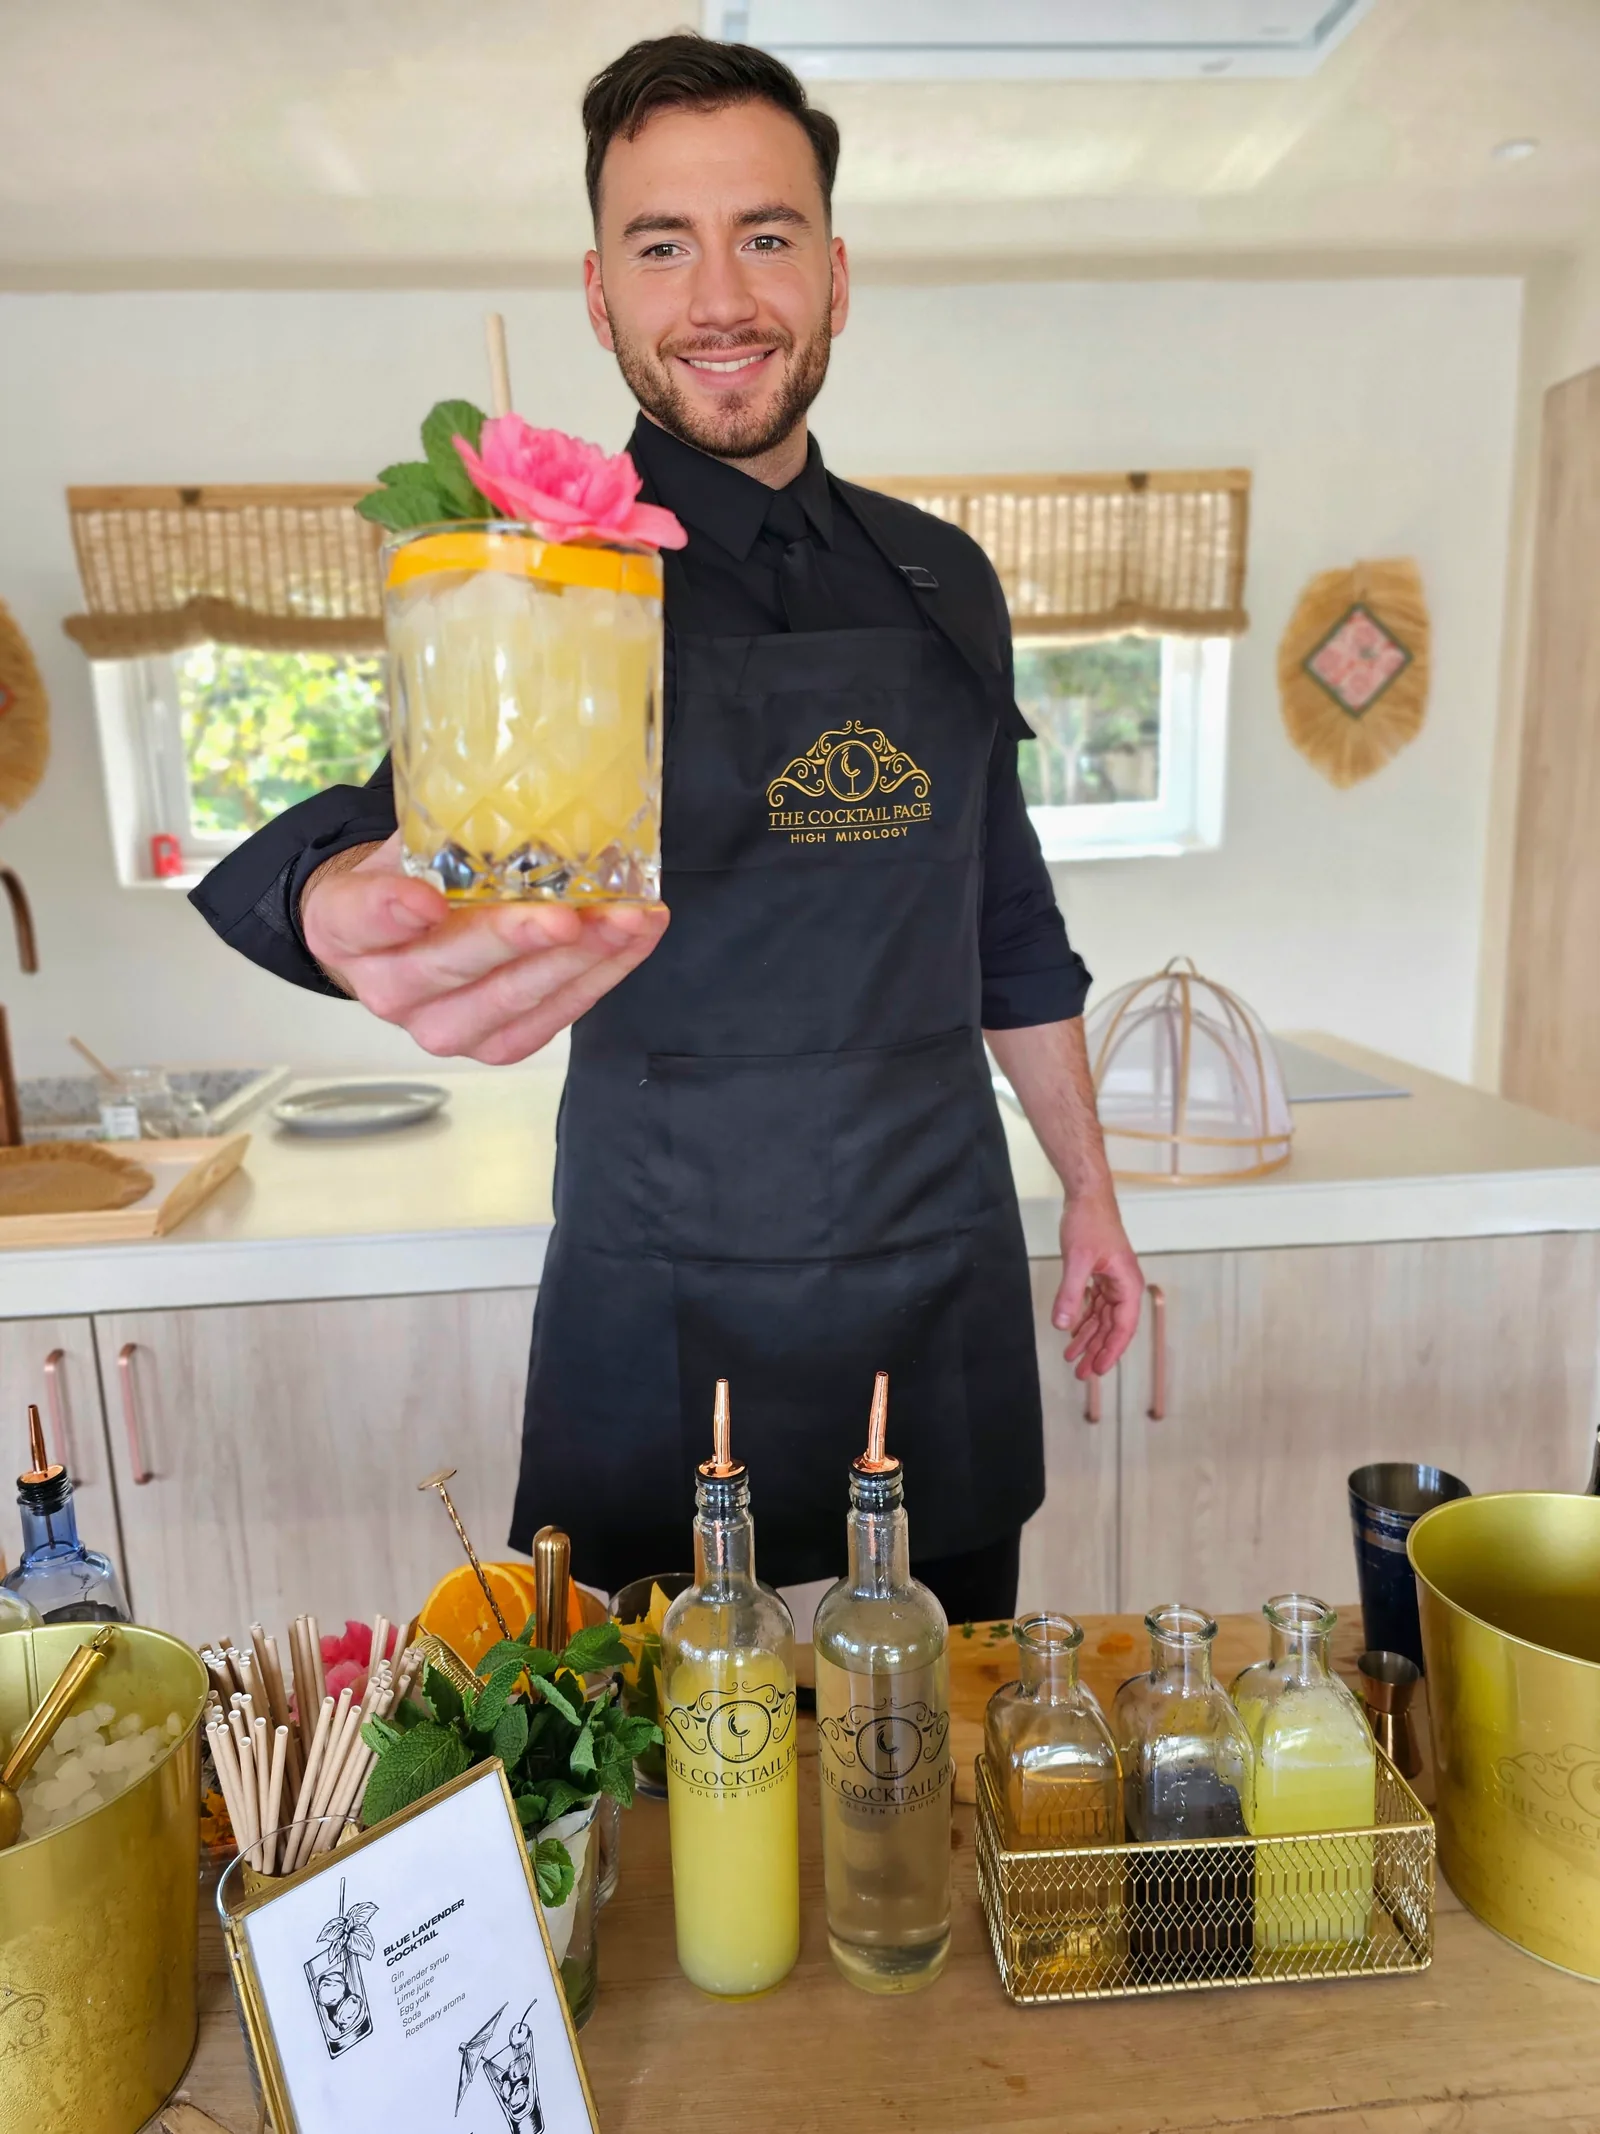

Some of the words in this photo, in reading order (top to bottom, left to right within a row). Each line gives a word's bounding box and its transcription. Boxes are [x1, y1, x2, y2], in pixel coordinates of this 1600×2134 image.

[768, 811, 804, 826] THE
[808, 806, 890, 825] COCKTAIL
[892, 802, 932, 819] FACE
[790, 833, 826, 844] HIGH
[835, 827, 908, 843] MIXOLOGY
[689, 1787, 737, 1799] GOLDEN
[746, 1770, 789, 1797] LIQUIDS
[691, 1757, 783, 1786] COCKTAIL
[840, 1777, 934, 1803] COCKTAIL
[383, 1933, 411, 1957] BLUE
[412, 1898, 465, 1938] LAVENDER
[386, 1929, 439, 1967] COCKTAIL
[391, 1969, 405, 1983] Gin
[394, 1966, 428, 1995] Lavender
[429, 1952, 450, 1971] syrup
[396, 1990, 416, 2006] Lime
[416, 1975, 435, 1994] juice
[400, 2000, 415, 2017] Egg
[415, 1990, 431, 2006] yolk
[402, 2010, 422, 2028] Soda
[405, 2009, 442, 2039] Rosemary
[443, 1992, 466, 2012] aroma
